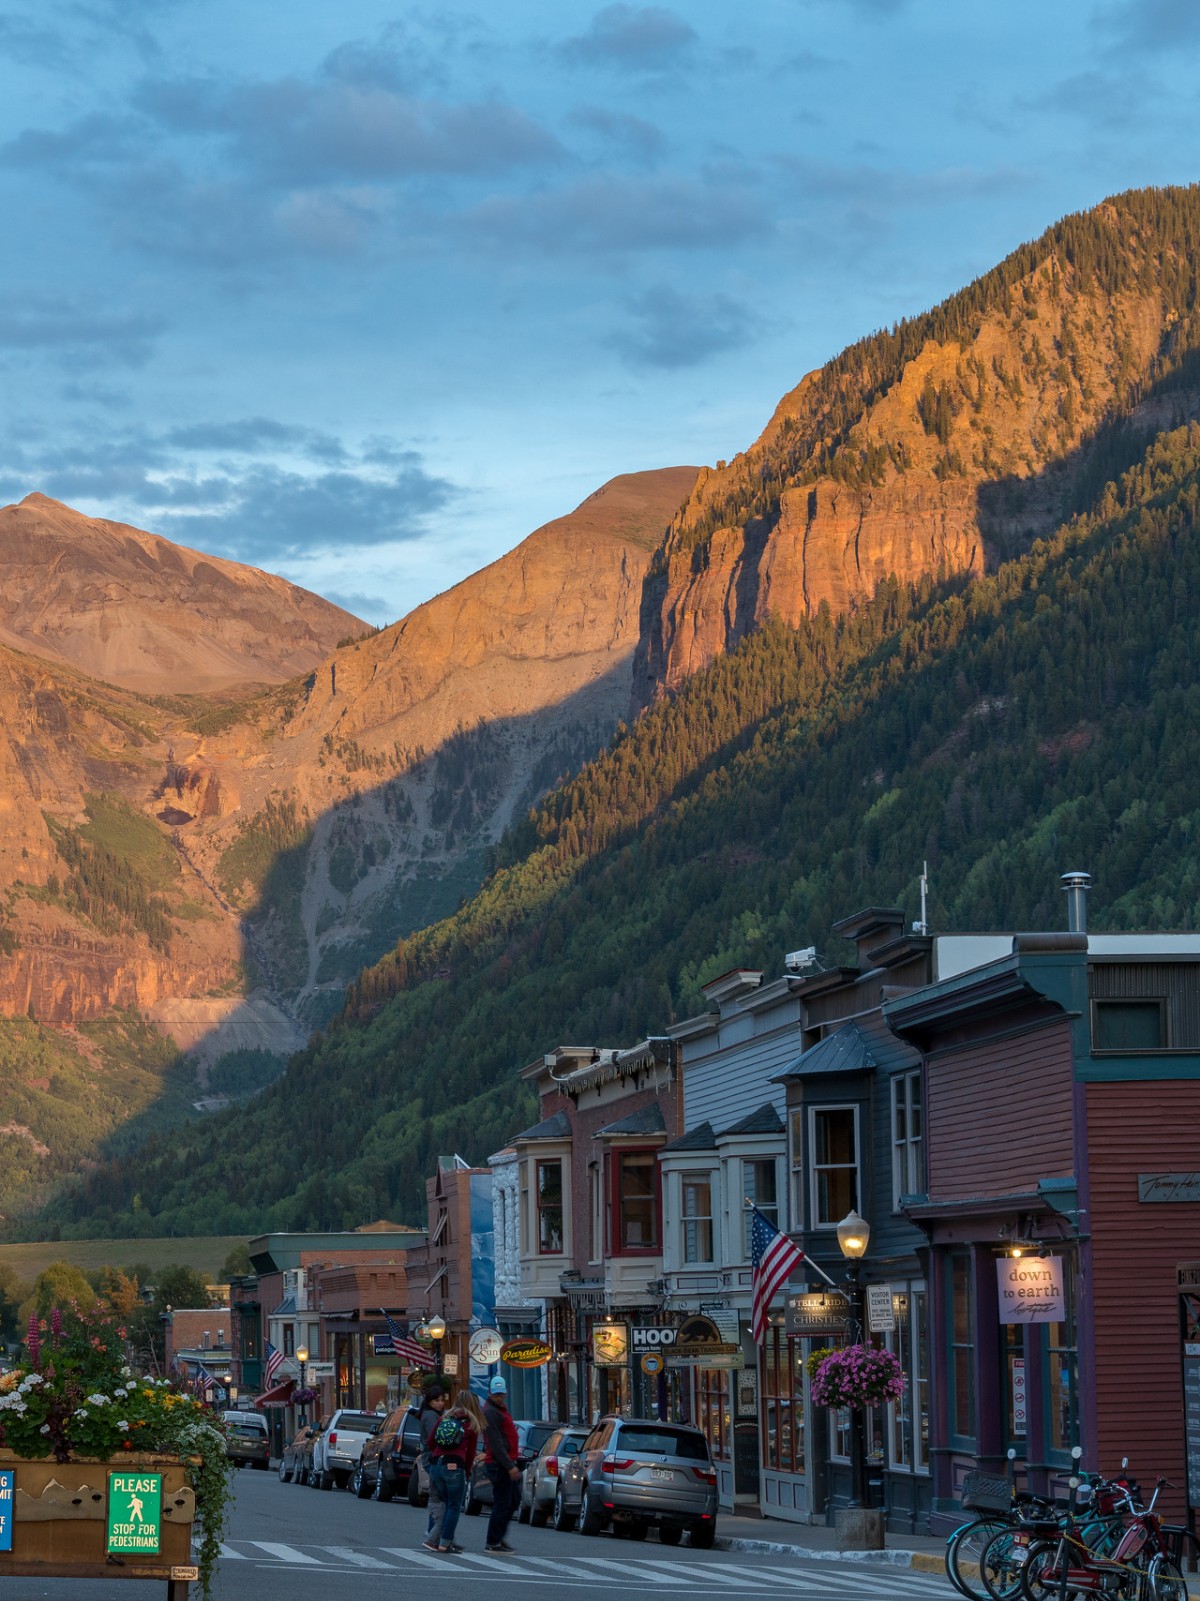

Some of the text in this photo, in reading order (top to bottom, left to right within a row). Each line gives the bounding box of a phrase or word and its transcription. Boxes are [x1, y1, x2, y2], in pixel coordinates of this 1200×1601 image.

[1009, 1269, 1052, 1281] down
[1003, 1283, 1060, 1298] to earth
[470, 1342, 488, 1356] Zia
[479, 1349, 498, 1361] Sun
[502, 1345, 549, 1361] Paradise
[113, 1478, 158, 1493] PLEASE
[113, 1523, 156, 1535] STOP FOR
[109, 1535, 159, 1548] PEDESTRIANS
